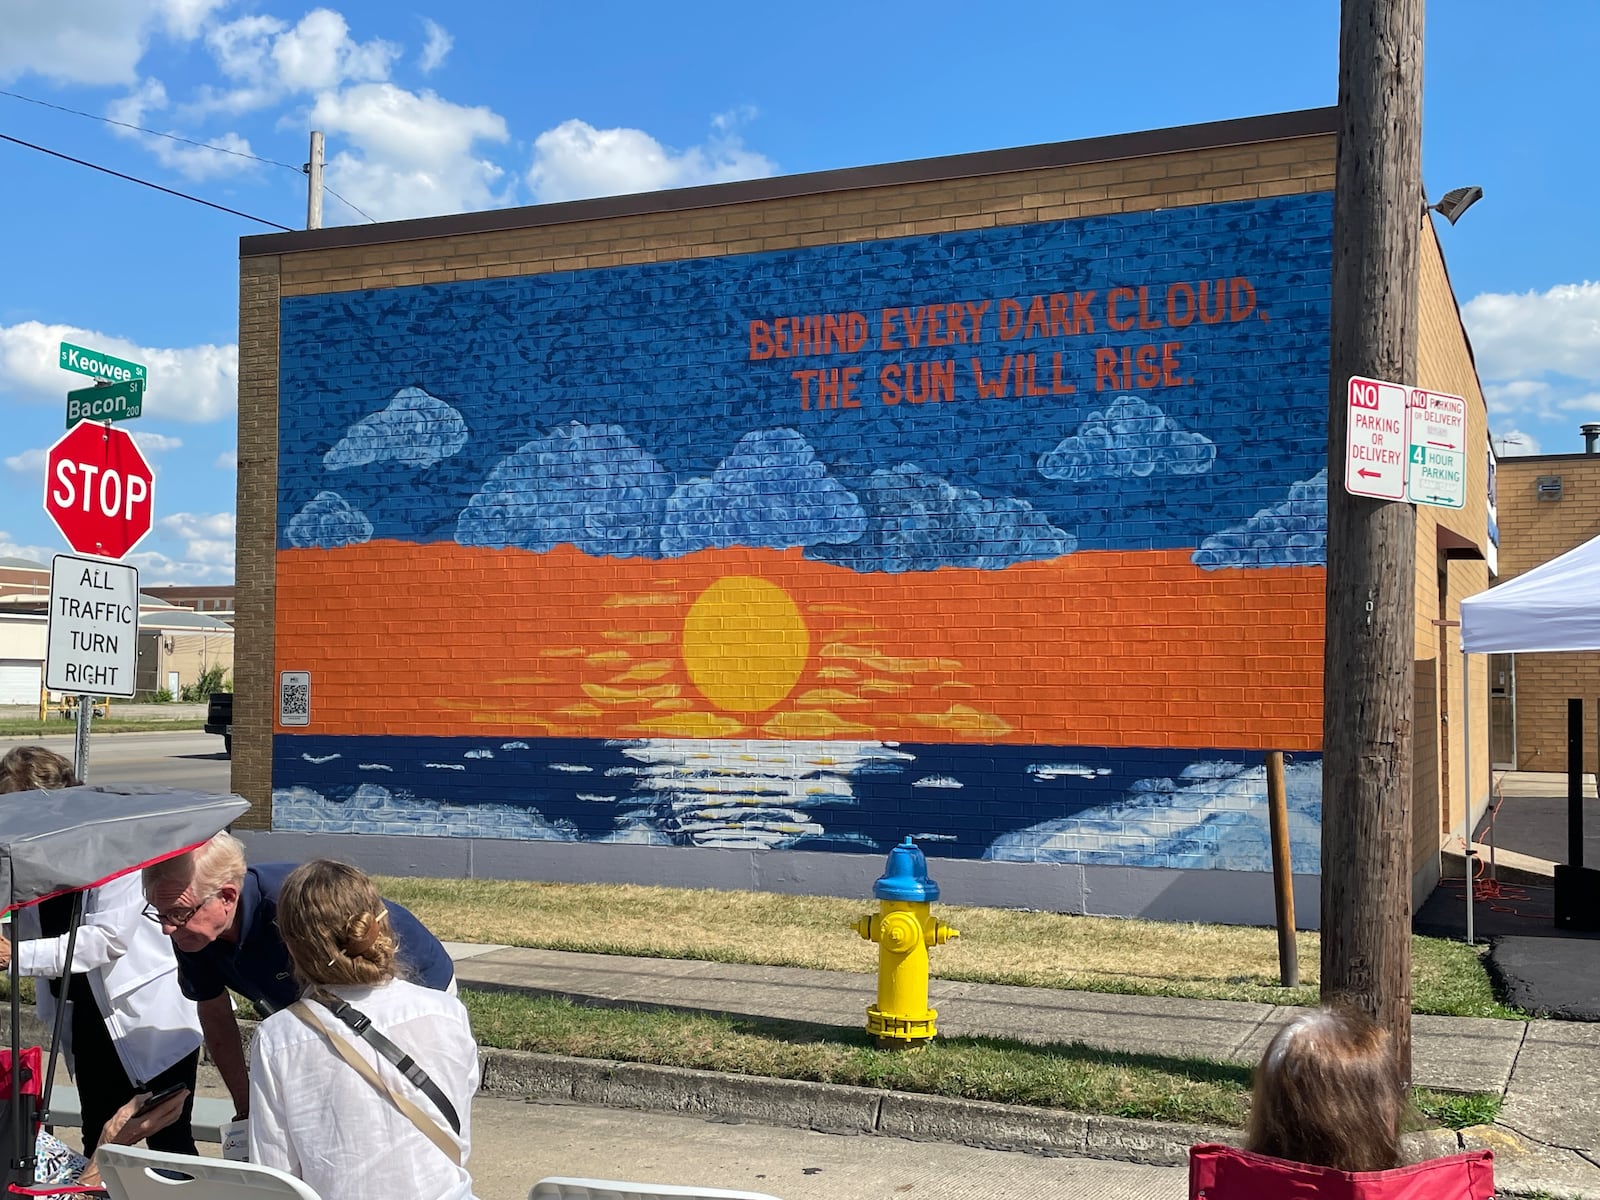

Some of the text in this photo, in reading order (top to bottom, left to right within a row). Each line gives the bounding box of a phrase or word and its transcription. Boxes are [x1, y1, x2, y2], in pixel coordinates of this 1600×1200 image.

[749, 277, 1270, 361] BEHIND EVERY DARK CLOUD,
[62, 349, 143, 381] S Keowee St
[792, 342, 1194, 411] THE SUN WILL RISE.
[69, 382, 139, 419] Bacon St 200
[1352, 383, 1377, 407] NO
[1412, 391, 1426, 408] NO
[1356, 413, 1400, 434] PARKING
[1424, 410, 1462, 427] DELIVERY
[1371, 433, 1384, 446] OR
[1352, 444, 1401, 465] DELIVERY
[1413, 446, 1454, 466] 4 HOUR
[1422, 466, 1460, 482] PARKING
[53, 459, 147, 520] STOP
[79, 567, 114, 590] ALL
[59, 596, 132, 624] TRAFFIC
[70, 630, 118, 654] TURN
[65, 663, 119, 686] RIGHT
